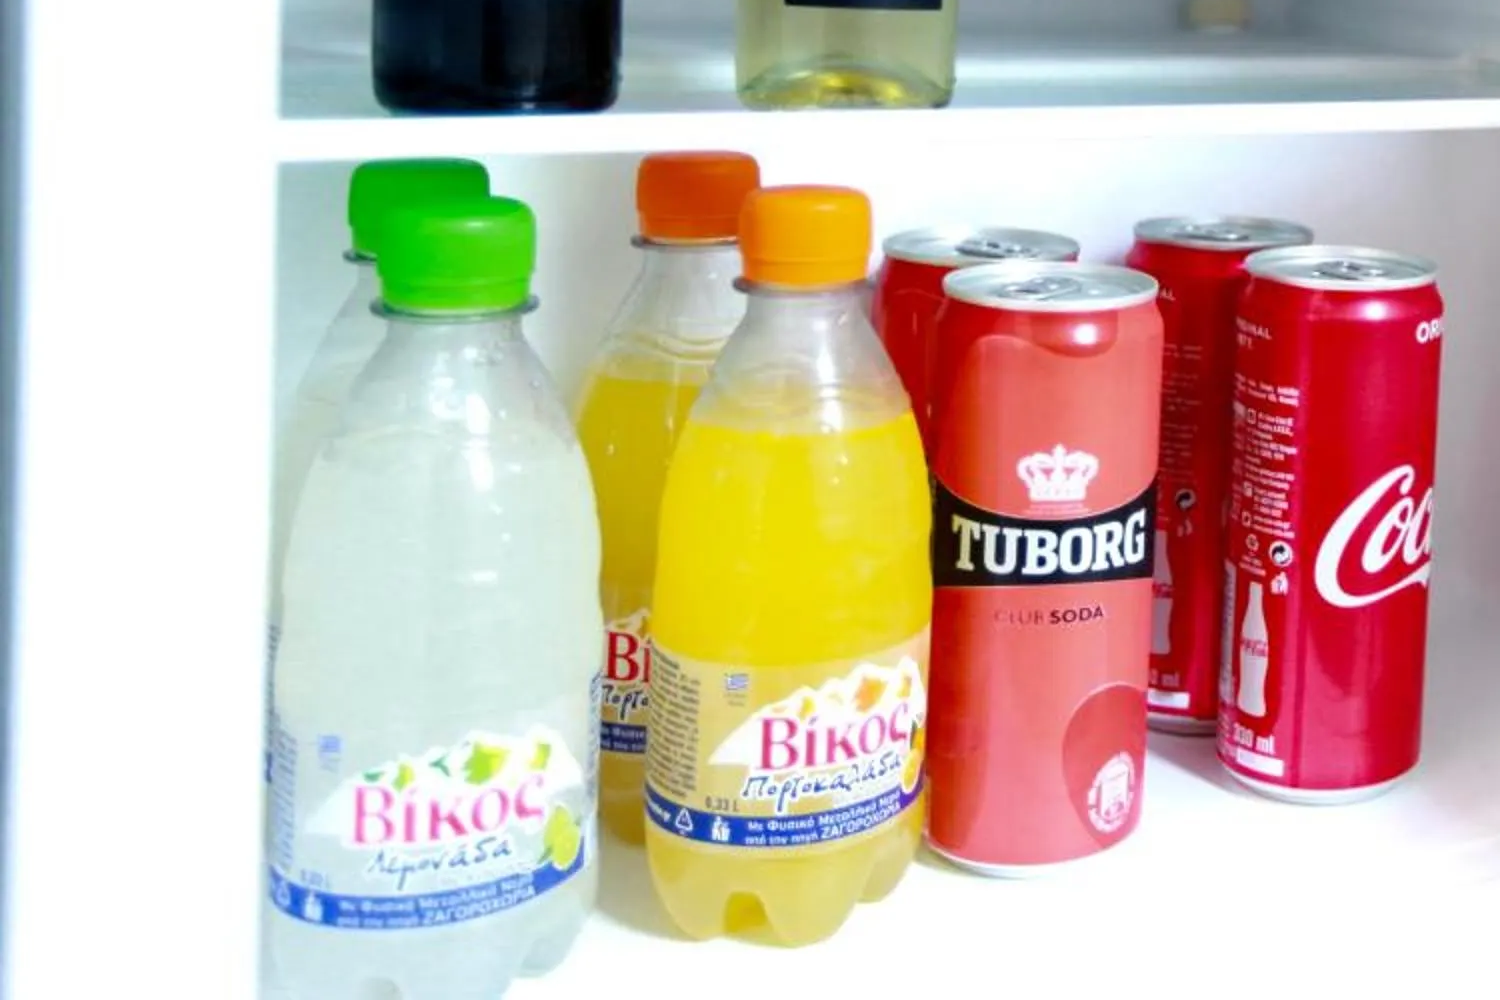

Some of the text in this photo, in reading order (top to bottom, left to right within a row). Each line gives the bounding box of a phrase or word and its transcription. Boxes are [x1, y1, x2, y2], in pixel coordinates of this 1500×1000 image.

[951, 508, 1146, 576] TUBORG
[993, 603, 1105, 626] CLUB SODA
[756, 701, 908, 771] Βίκος
[353, 774, 544, 845] Βίκος
